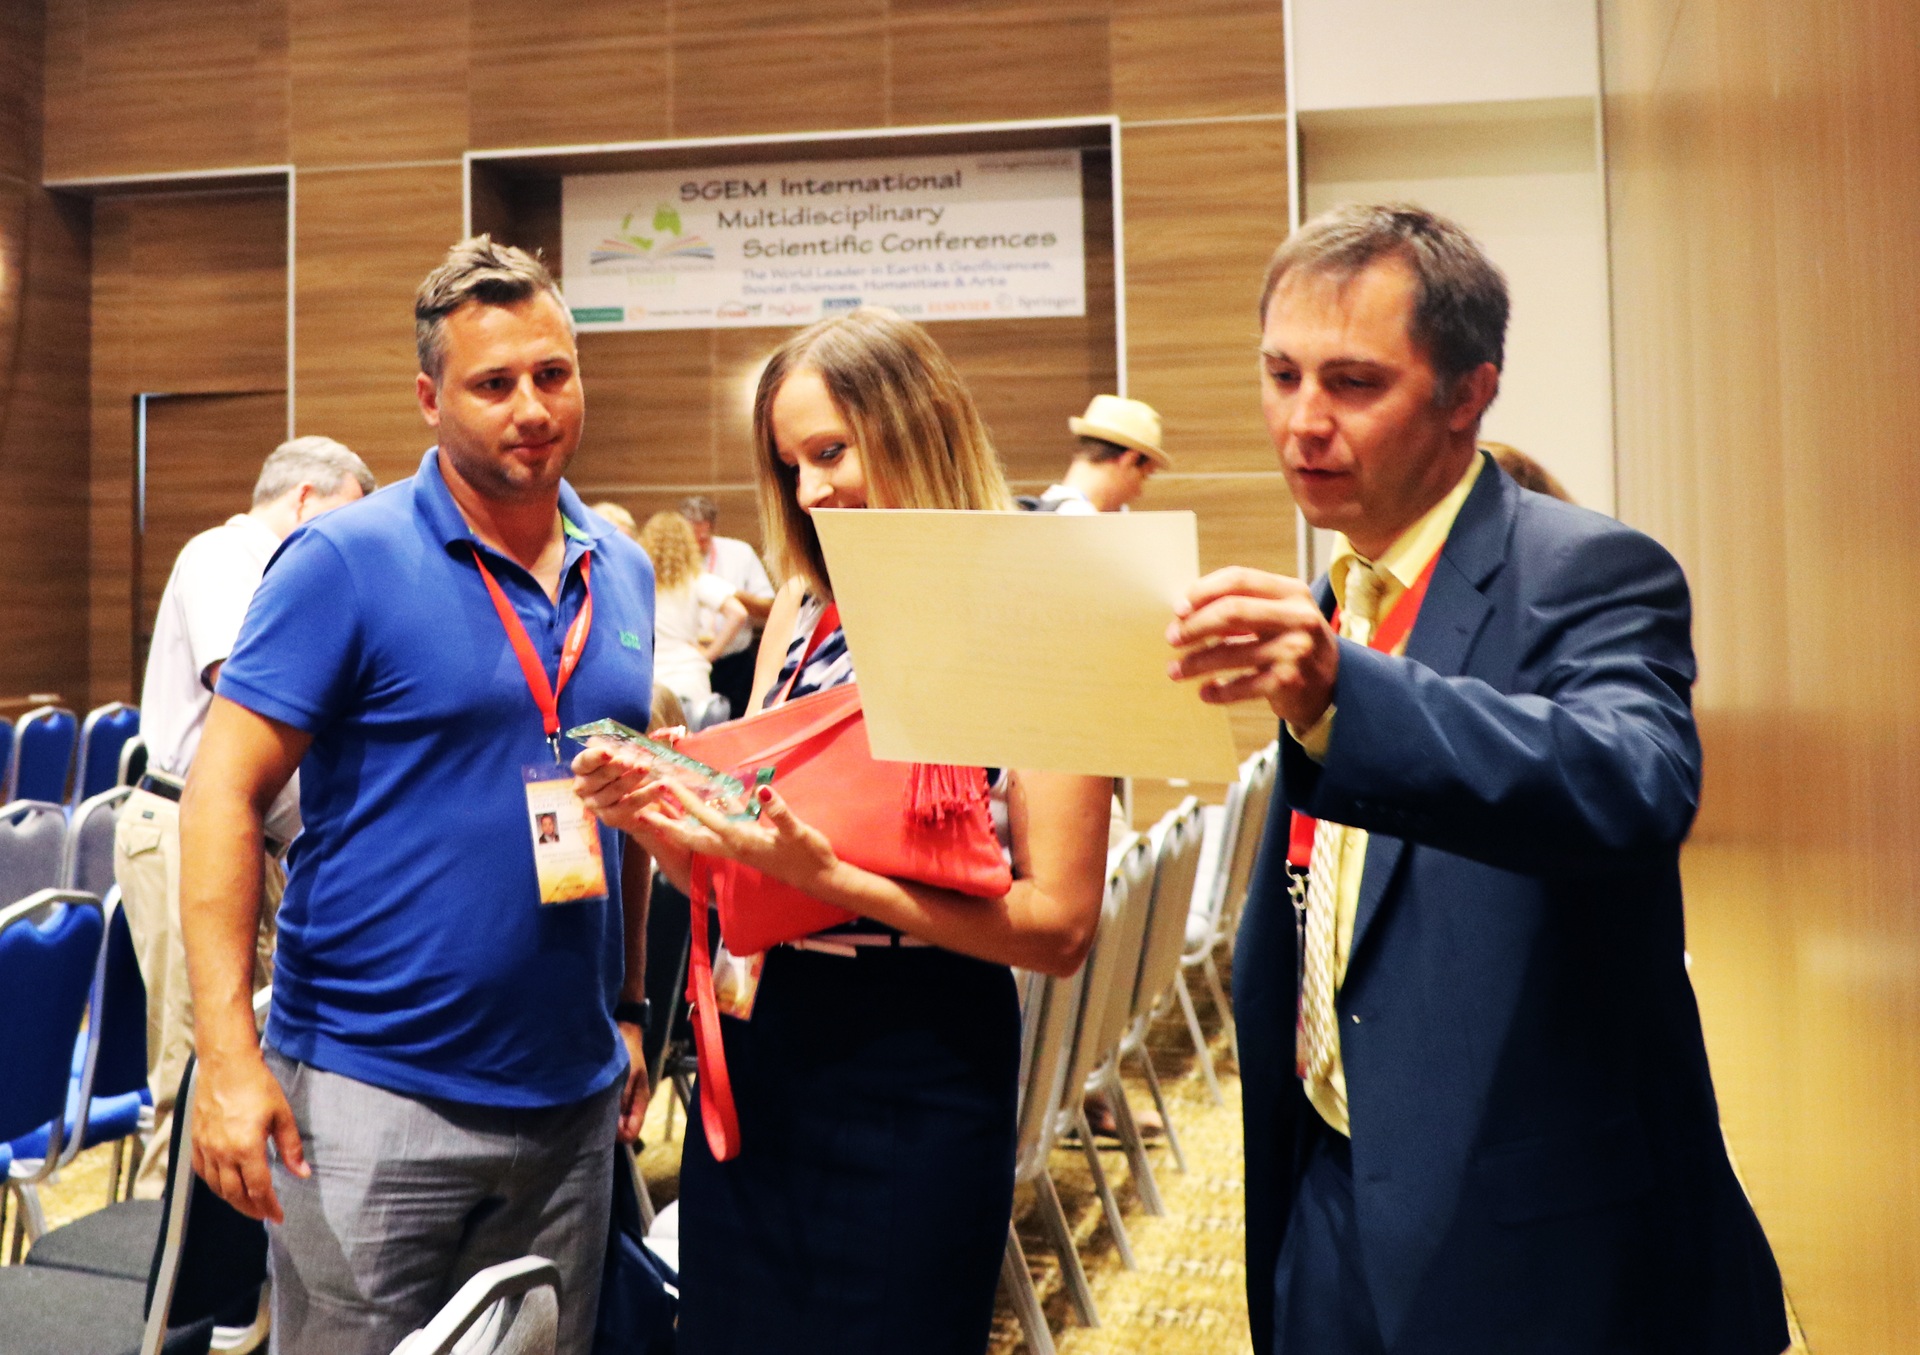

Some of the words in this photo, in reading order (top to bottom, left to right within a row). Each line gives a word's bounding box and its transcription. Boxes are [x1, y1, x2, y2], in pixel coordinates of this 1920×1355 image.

[680, 178, 767, 202] SGEM
[781, 169, 962, 197] International
[718, 204, 945, 230] Multidisciplinary
[743, 235, 873, 258] Scientific
[881, 230, 1057, 254] Conferences
[887, 261, 931, 275] Earth
